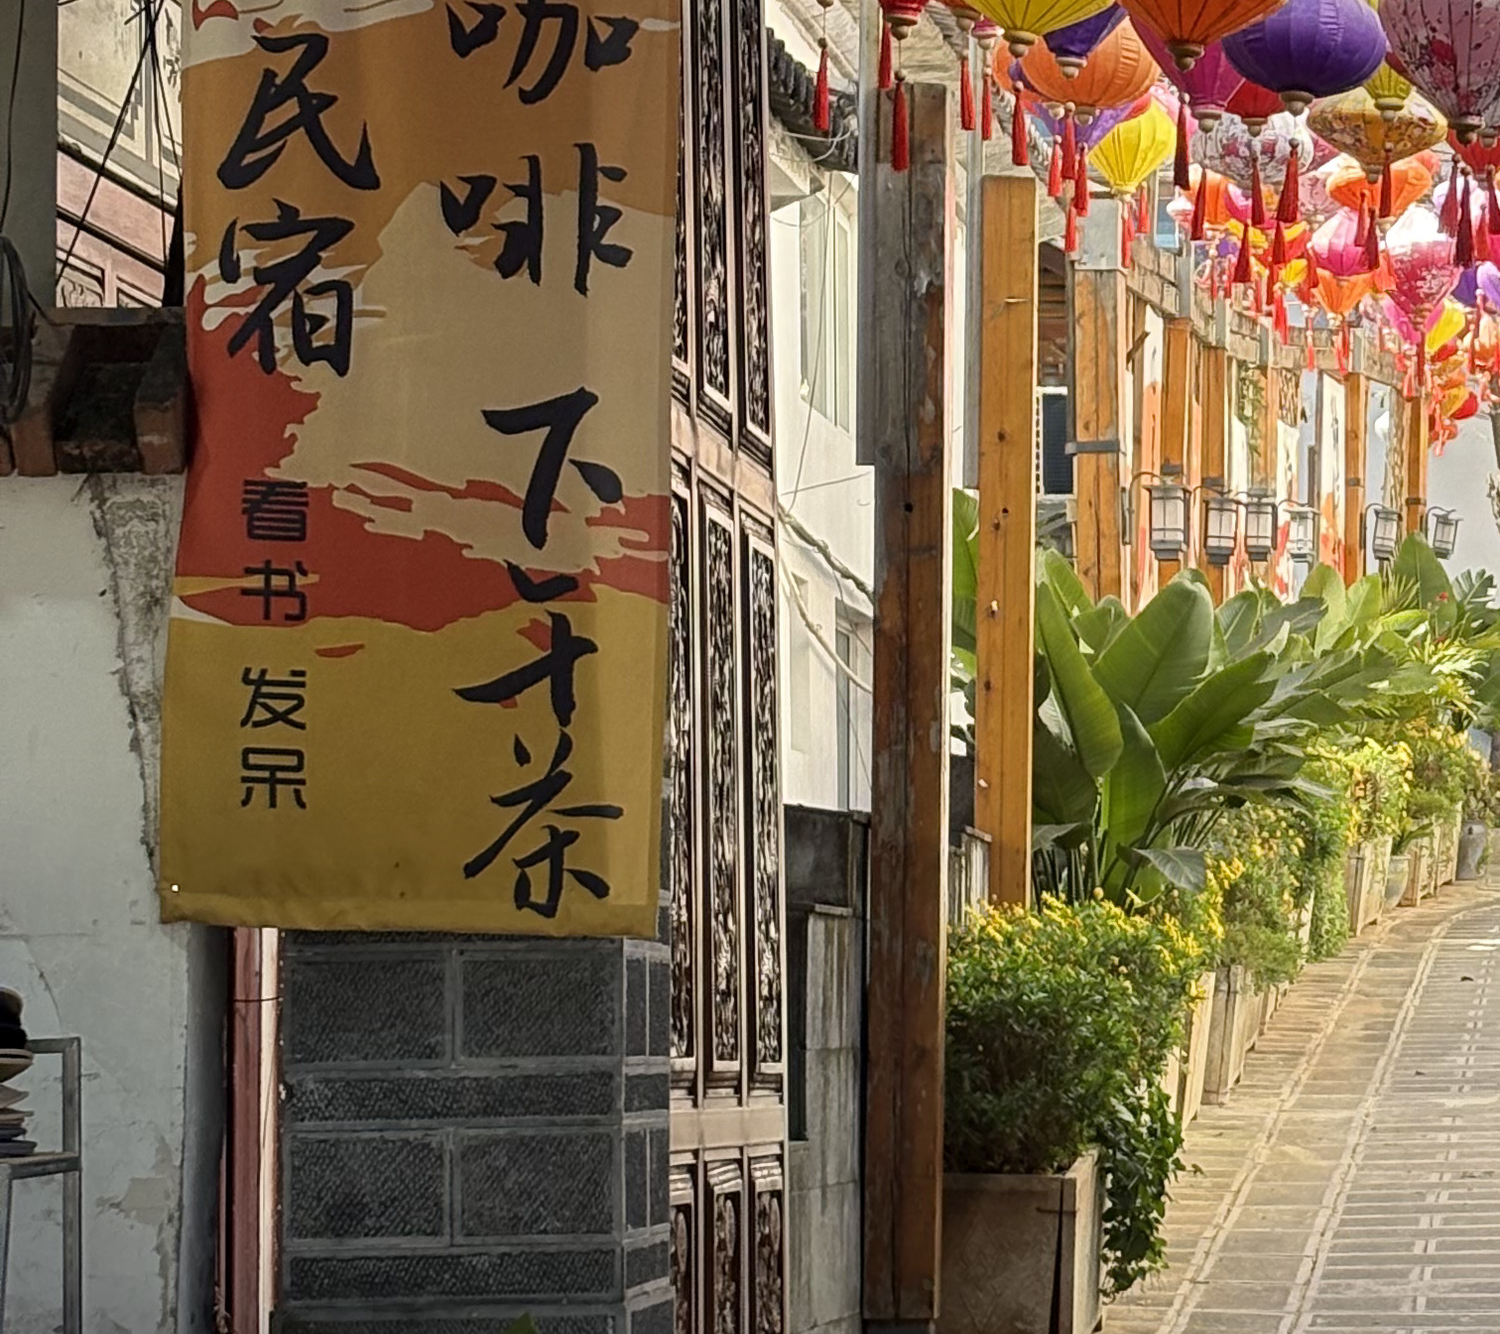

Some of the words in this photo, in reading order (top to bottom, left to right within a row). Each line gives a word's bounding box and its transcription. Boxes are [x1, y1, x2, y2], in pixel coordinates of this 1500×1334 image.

[216, 33, 382, 376] 民宿
[239, 479, 310, 624] 看书
[450, 384, 623, 919] 下午茶
[239, 666, 309, 811] 发呆
